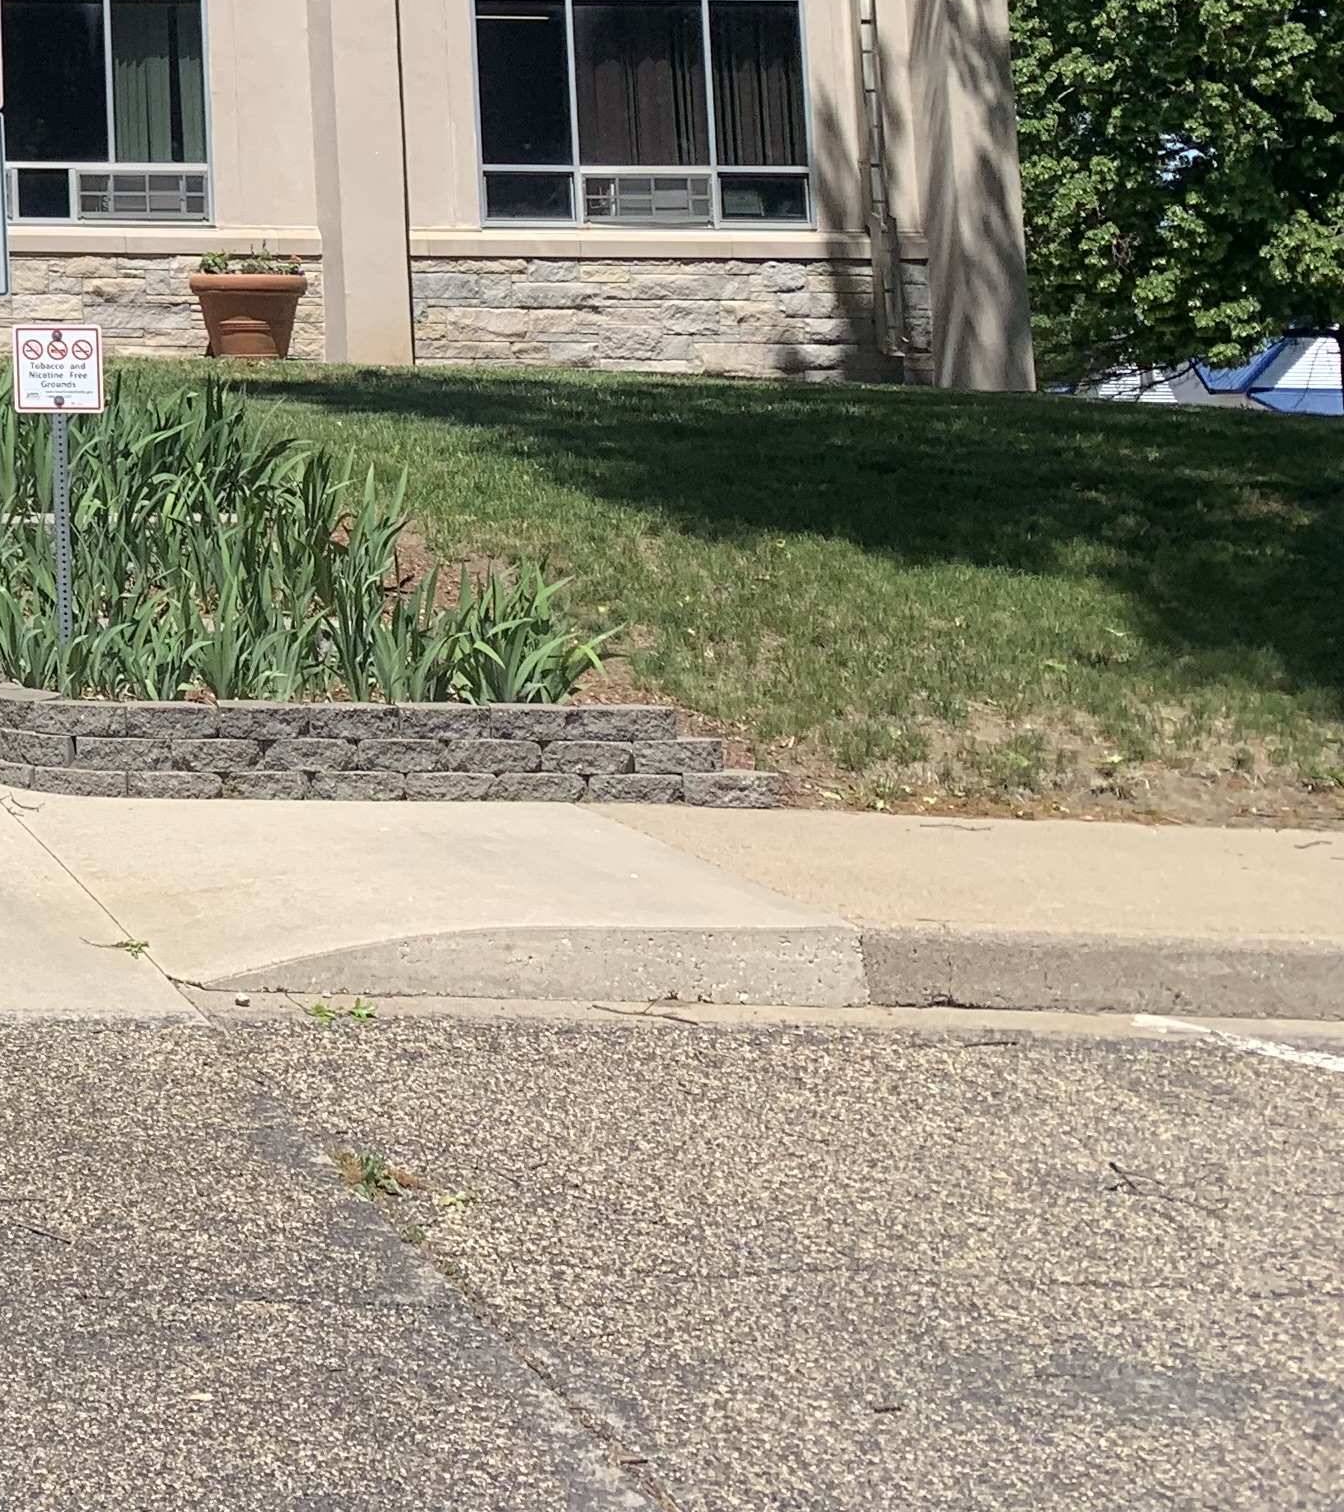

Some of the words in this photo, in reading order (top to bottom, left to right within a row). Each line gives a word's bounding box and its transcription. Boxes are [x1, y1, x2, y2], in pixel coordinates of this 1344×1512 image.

[30, 362, 65, 370] Tobacco
[69, 362, 86, 370] and
[28, 371, 64, 379] Nicotine
[69, 371, 88, 379] Free
[40, 380, 76, 388] Grounds
